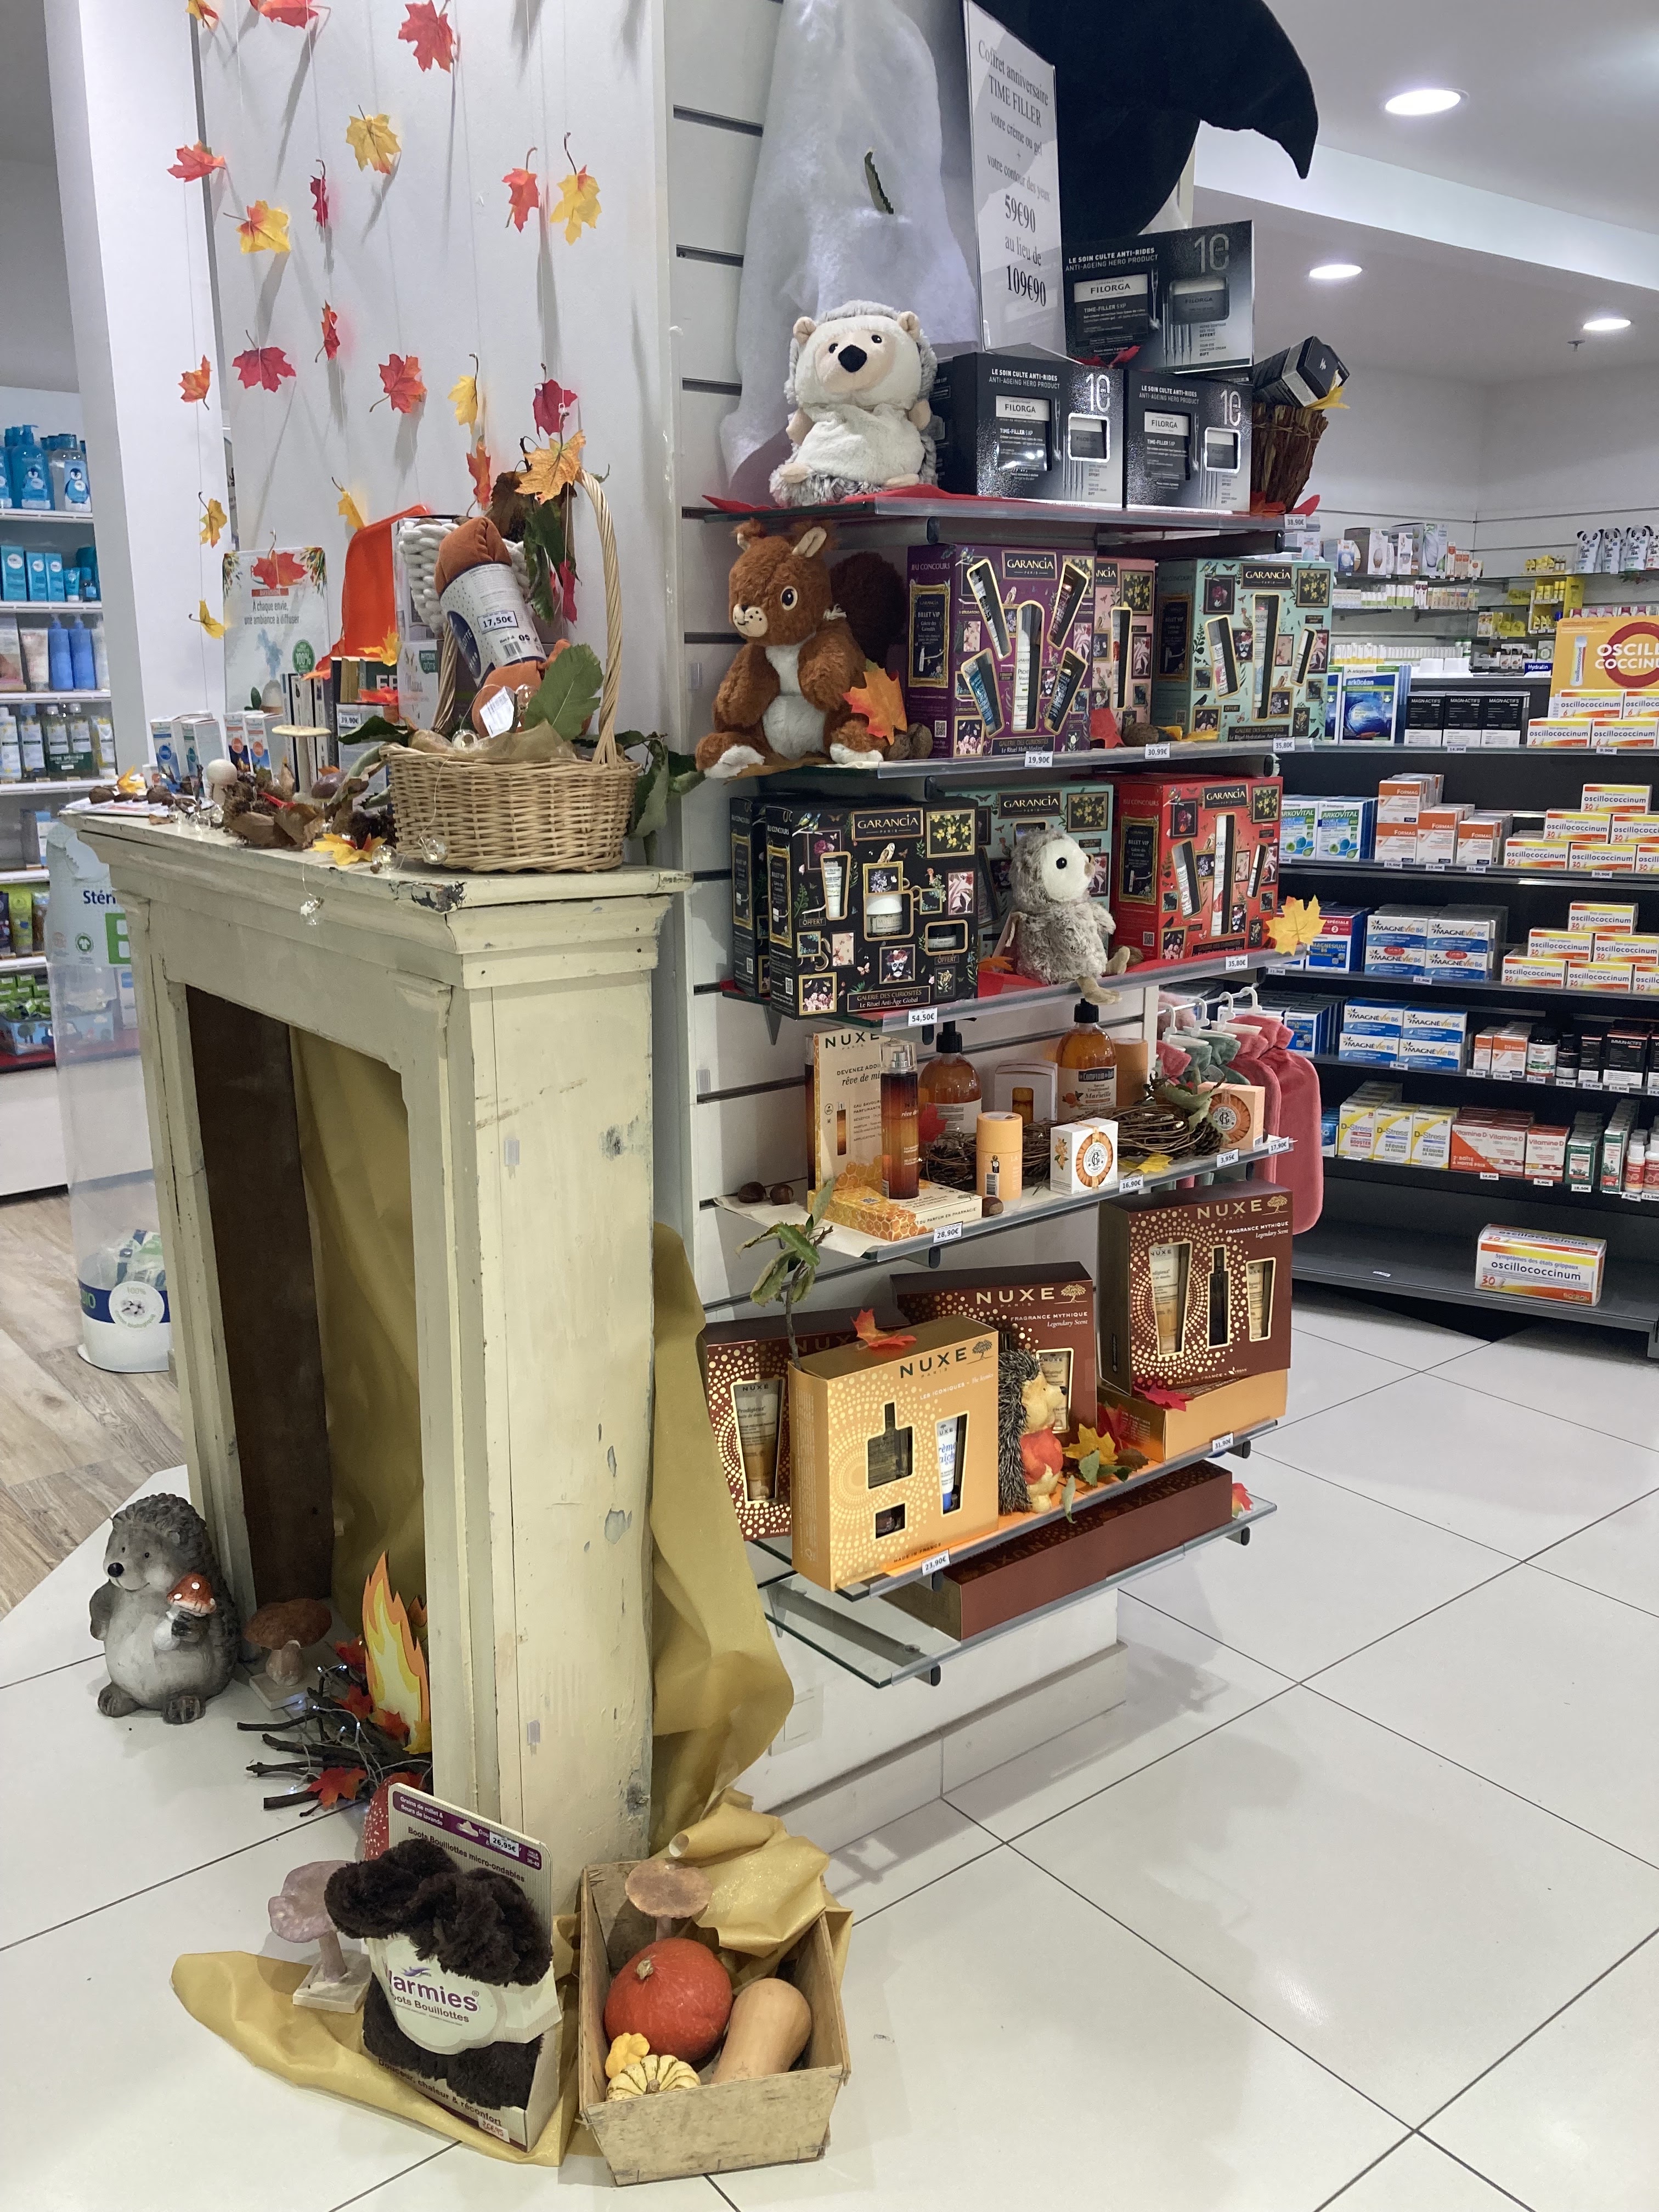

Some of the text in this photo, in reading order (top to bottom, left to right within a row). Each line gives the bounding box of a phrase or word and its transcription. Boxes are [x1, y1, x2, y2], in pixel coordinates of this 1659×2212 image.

[979, 40, 1048, 106] Coffret anniversaire
[989, 74, 1042, 128] TIME FILLER
[990, 112, 1042, 156] votre crème ou gel
[1017, 149, 1021, 161] +
[987, 154, 1050, 202] votre contour des yeux
[1005, 194, 1036, 233] 59€90
[1005, 235, 1042, 266] au lieu de
[1095, 252, 1115, 261] CULTE
[1117, 248, 1155, 258] ANTI-RIDES
[1194, 233, 1229, 273] 10
[1065, 261, 1107, 272] ANTI-AGEING
[1128, 255, 1159, 264] PRODUCT
[1006, 265, 1046, 307] 109€90
[1091, 284, 1131, 294] FILORGA
[1084, 304, 1115, 313] TIME-FILLER
[989, 376, 1022, 385] ANTI-AGEING
[1037, 381, 1060, 390] PRODUCT
[1029, 373, 1057, 381] ANTI-RIDES
[1086, 374, 1110, 412] 10
[1005, 404, 1036, 413] FILORGA
[1221, 390, 1241, 426] 10
[1152, 420, 1177, 428] FILORGA
[1007, 557, 1054, 569] GARANCIA
[1246, 569, 1290, 579] GARANCIA
[257, 602, 273, 613] chaque
[274, 601, 289, 611] envie,
[244, 614, 300, 625] une ambiance à diffuser
[483, 617, 512, 628] 17,50€
[296, 652, 311, 665] 100%
[1148, 748, 1167, 757] 30,99€
[1584, 795, 1646, 804] oscillococcinum
[857, 814, 919, 830] GARANCIA
[1547, 823, 1607, 833] oscillococcinum
[772, 826, 789, 835] CONCOURS
[891, 989, 922, 997] CURIOSITÉS
[912, 1013, 935, 1022] 54,50€
[837, 1066, 864, 1076] DEVENEZ
[842, 1076, 858, 1086] rêve
[1341, 1123, 1372, 1132] D-Stress
[1377, 1127, 1408, 1136] D-Stress
[1414, 1131, 1446, 1140] D-Stress
[1489, 1133, 1517, 1142] Vitamine
[1271, 1141, 1287, 1151] 17,90€
[1221, 1154, 1235, 1163] 3,95€
[1122, 1180, 1142, 1188] 16,90€
[952, 1207, 976, 1216] PHARMACIE
[1197, 1199, 1262, 1220] NUXE
[937, 1228, 959, 1239] 28,90€
[1226, 1221, 1289, 1234] FRAGRANCE MYTHIQUE
[1496, 1254, 1527, 1262] Symptômes
[1554, 1262, 1578, 1270] grippaux
[1491, 1261, 1581, 1280] oscillococcinum
[1481, 1275, 1496, 1285] 30
[127, 1286, 146, 1295] 100%
[977, 1287, 1055, 1305] NUXE
[1047, 1320, 1073, 1328] Legendary
[900, 1347, 967, 1379] NUXE
[921, 1367, 948, 1378] PARIS
[932, 1382, 965, 1396] ICONIQUES
[1215, 1438, 1231, 1449] 31,90€
[894, 1555, 909, 1563] MADE
[919, 1543, 941, 1554] FRANCE
[925, 1557, 946, 1571] 23,90€
[400, 1796, 416, 1808] Grains
[425, 1806, 438, 1817] millet
[400, 1804, 443, 1825] fleurs de lavande
[493, 1838, 517, 1852] 26,95€
[408, 1826, 524, 1882] Boots Bouillottes micro-ondables
[415, 2000, 469, 2022] Bouillottes
[379, 2058, 416, 2084] Douceur,
[418, 2080, 449, 2099] chaleur
[461, 2101, 502, 2127] réconfort
